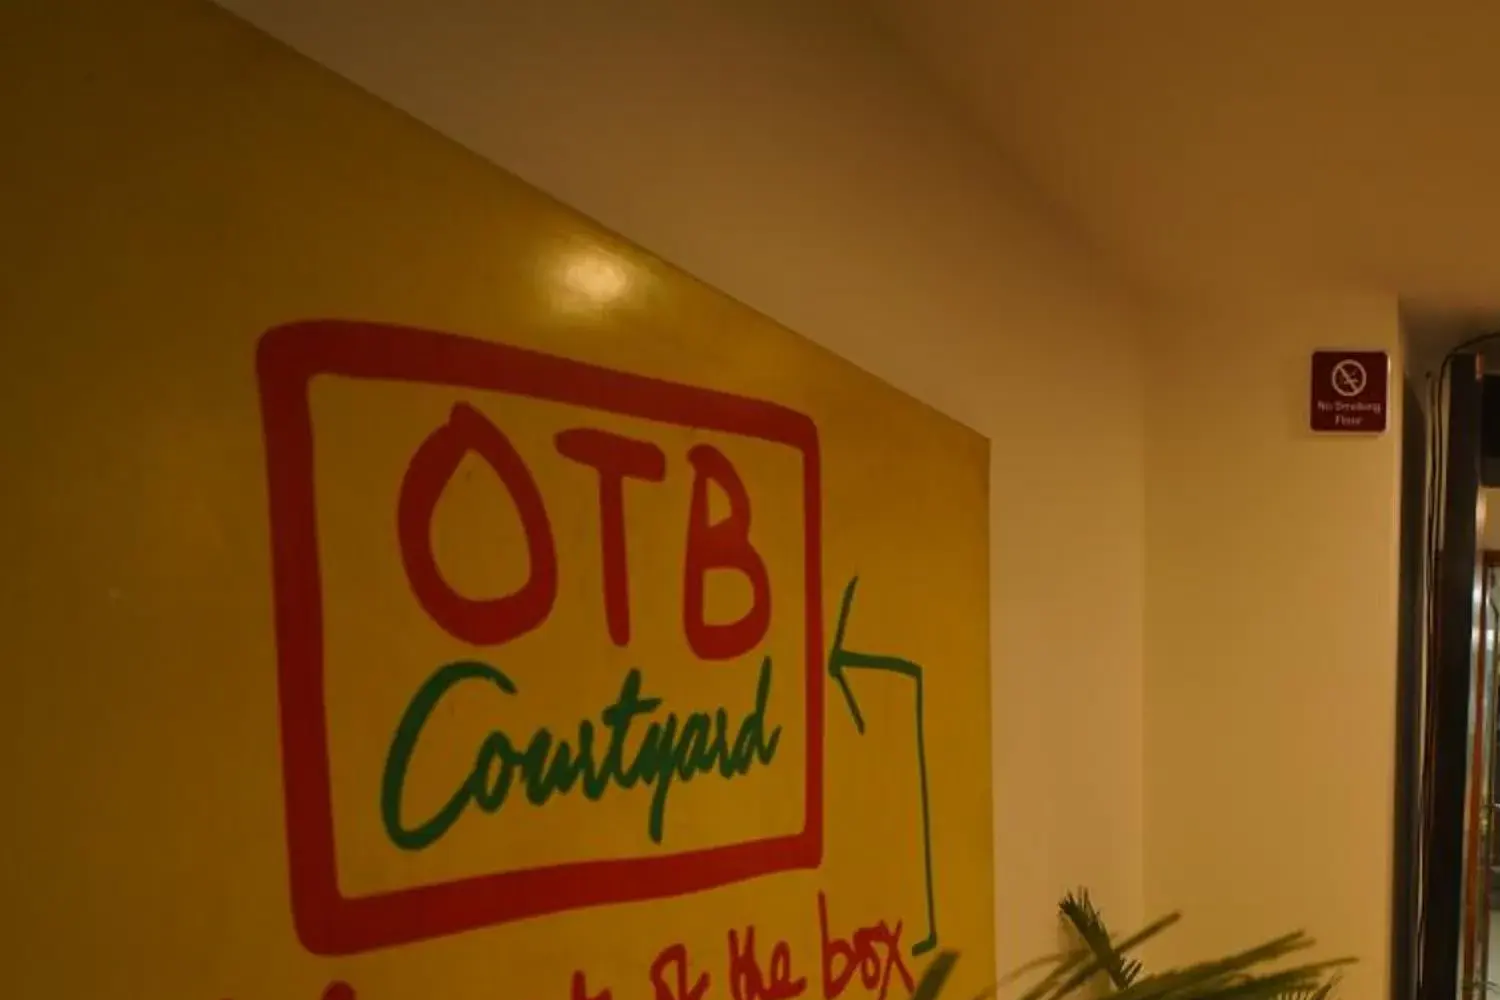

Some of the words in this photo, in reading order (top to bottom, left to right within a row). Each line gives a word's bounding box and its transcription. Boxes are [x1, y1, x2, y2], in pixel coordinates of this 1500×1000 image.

[1317, 401, 1333, 412] No
[1335, 401, 1382, 415] Smoking
[1335, 415, 1363, 426] Floor
[398, 402, 771, 660] OTB
[381, 656, 781, 851] Courtyard
